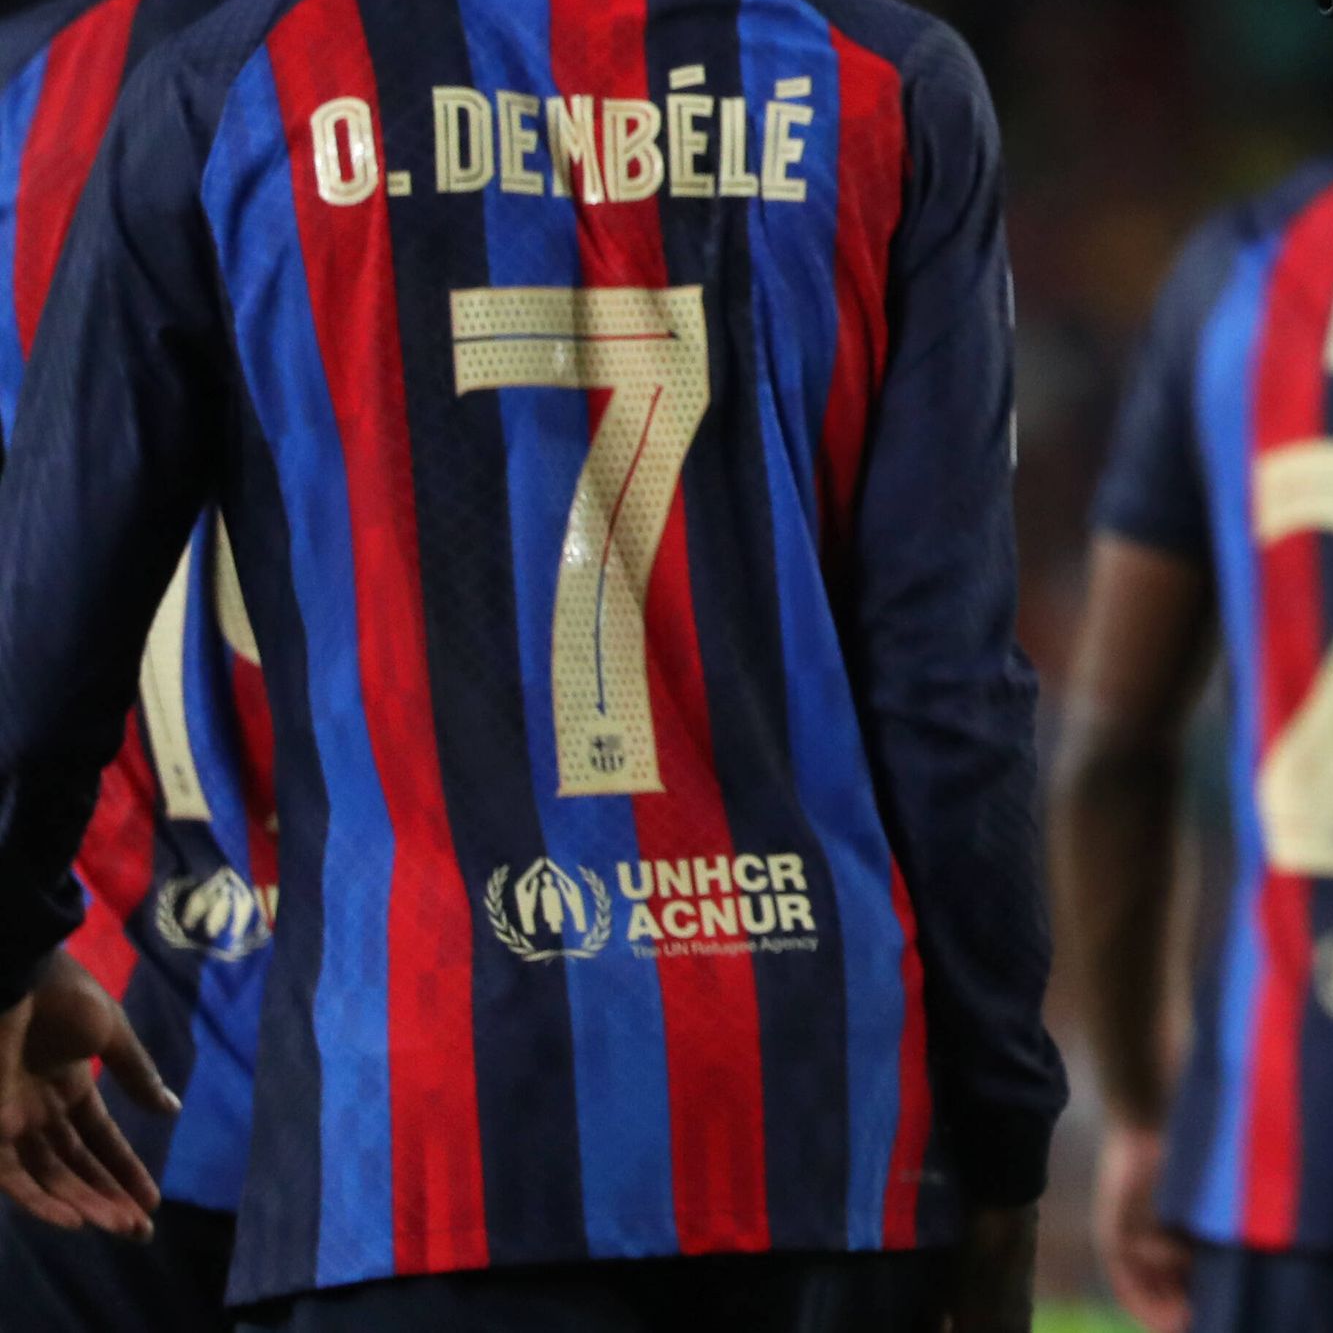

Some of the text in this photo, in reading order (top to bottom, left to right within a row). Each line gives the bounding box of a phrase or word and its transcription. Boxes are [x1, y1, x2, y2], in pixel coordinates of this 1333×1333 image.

[311, 64, 814, 206] O. DEMBÉLÉ
[449, 285, 710, 797] 7
[616, 852, 808, 901] UNHCR
[627, 894, 816, 941] ACNUR
